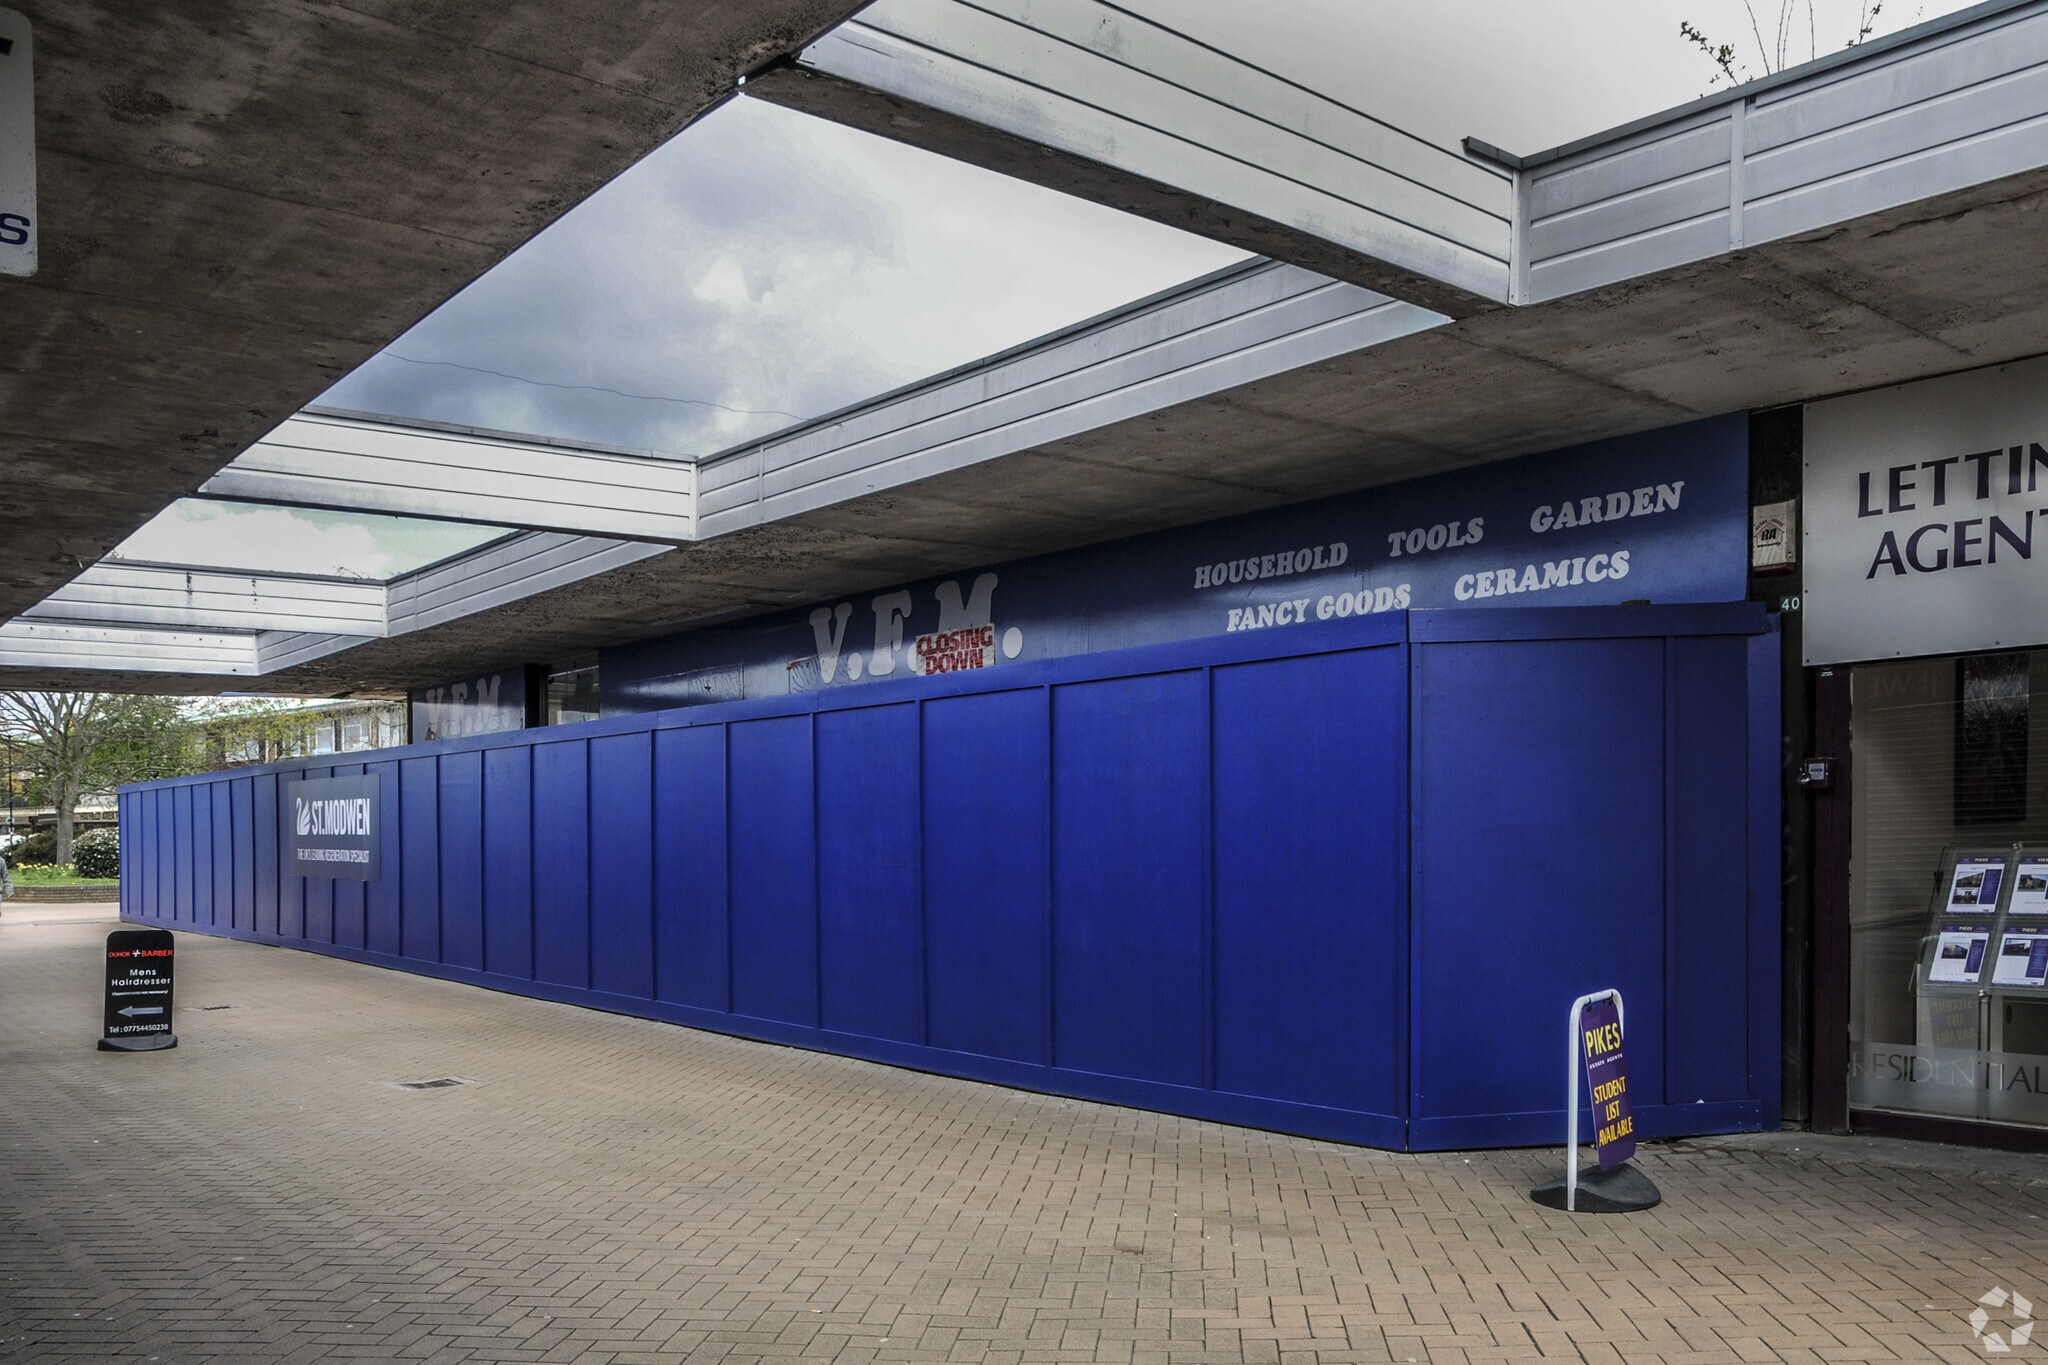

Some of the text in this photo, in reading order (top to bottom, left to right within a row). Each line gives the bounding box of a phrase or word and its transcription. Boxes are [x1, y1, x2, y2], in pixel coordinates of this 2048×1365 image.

[1194, 480, 1685, 589] HOUSEHOLD TOOLS GARDEN
[1866, 508, 2048, 580] AGEN
[1454, 549, 1631, 601] CERAMICS
[1226, 583, 1411, 632] FANCY GOODS
[1781, 597, 1800, 611] 40
[916, 625, 993, 657] CLOSING
[925, 648, 984, 675] DOWN
[141, 949, 173, 957] BARBER
[111, 978, 171, 986] Hairdresser
[1585, 1022, 1620, 1057] PIKES
[1852, 1052, 2048, 1093] RESIDENTIAL
[1594, 1076, 1626, 1104] STUDENT
[1605, 1100, 1620, 1121] LIST
[1599, 1116, 1633, 1147] AVAILABLE
